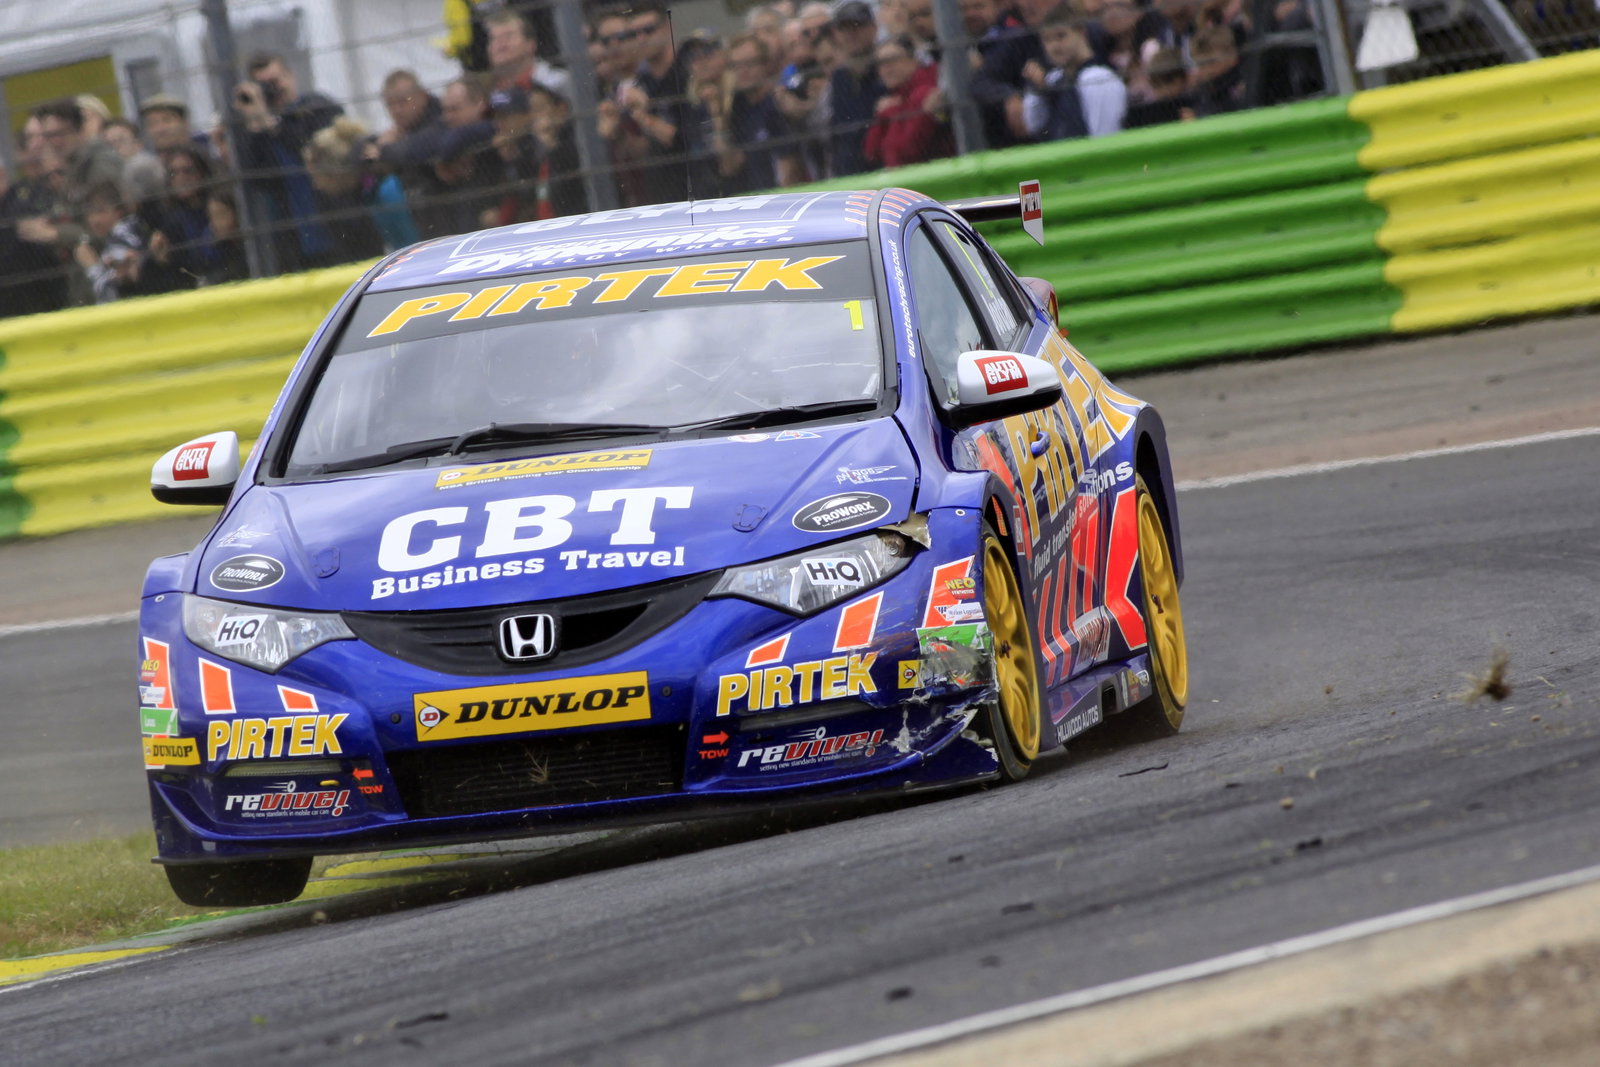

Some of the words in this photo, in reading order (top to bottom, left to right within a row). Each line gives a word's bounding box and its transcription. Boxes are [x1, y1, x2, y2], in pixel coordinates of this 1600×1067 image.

[437, 226, 796, 275] Dynamics
[516, 252, 632, 269] ALLOY
[655, 236, 795, 254] WHEELS
[366, 255, 846, 338] PIRTEK
[888, 239, 916, 359] eurotechracing.co.uk
[843, 300, 865, 330] 1
[983, 360, 1018, 375] AUTO
[987, 367, 1023, 385] GLYM
[176, 458, 206, 471] GLYM
[180, 447, 209, 461] AUTO
[474, 453, 648, 475] DUNLOP
[465, 477, 500, 486] British
[503, 471, 542, 481] Touring
[566, 465, 642, 474] Championship
[812, 501, 875, 526] PROWORX
[377, 486, 694, 573] CBT
[370, 557, 545, 600] Business
[559, 546, 685, 571] Travel
[806, 561, 860, 582] HiQ
[944, 577, 976, 589] NEO
[218, 618, 260, 641] HiQ
[142, 660, 160, 671] NEO
[716, 651, 879, 717] PIRTEK
[454, 685, 645, 723] DUNLOP
[1082, 705, 1099, 729] AUTOS
[207, 713, 350, 761] PIRTEK
[737, 728, 884, 767] revive!
[153, 744, 193, 757] DUNLOP
[699, 749, 730, 759] TOW
[759, 763, 778, 771] setting
[791, 757, 817, 766] standards
[358, 785, 383, 793] TOW
[225, 789, 351, 816] revive!
